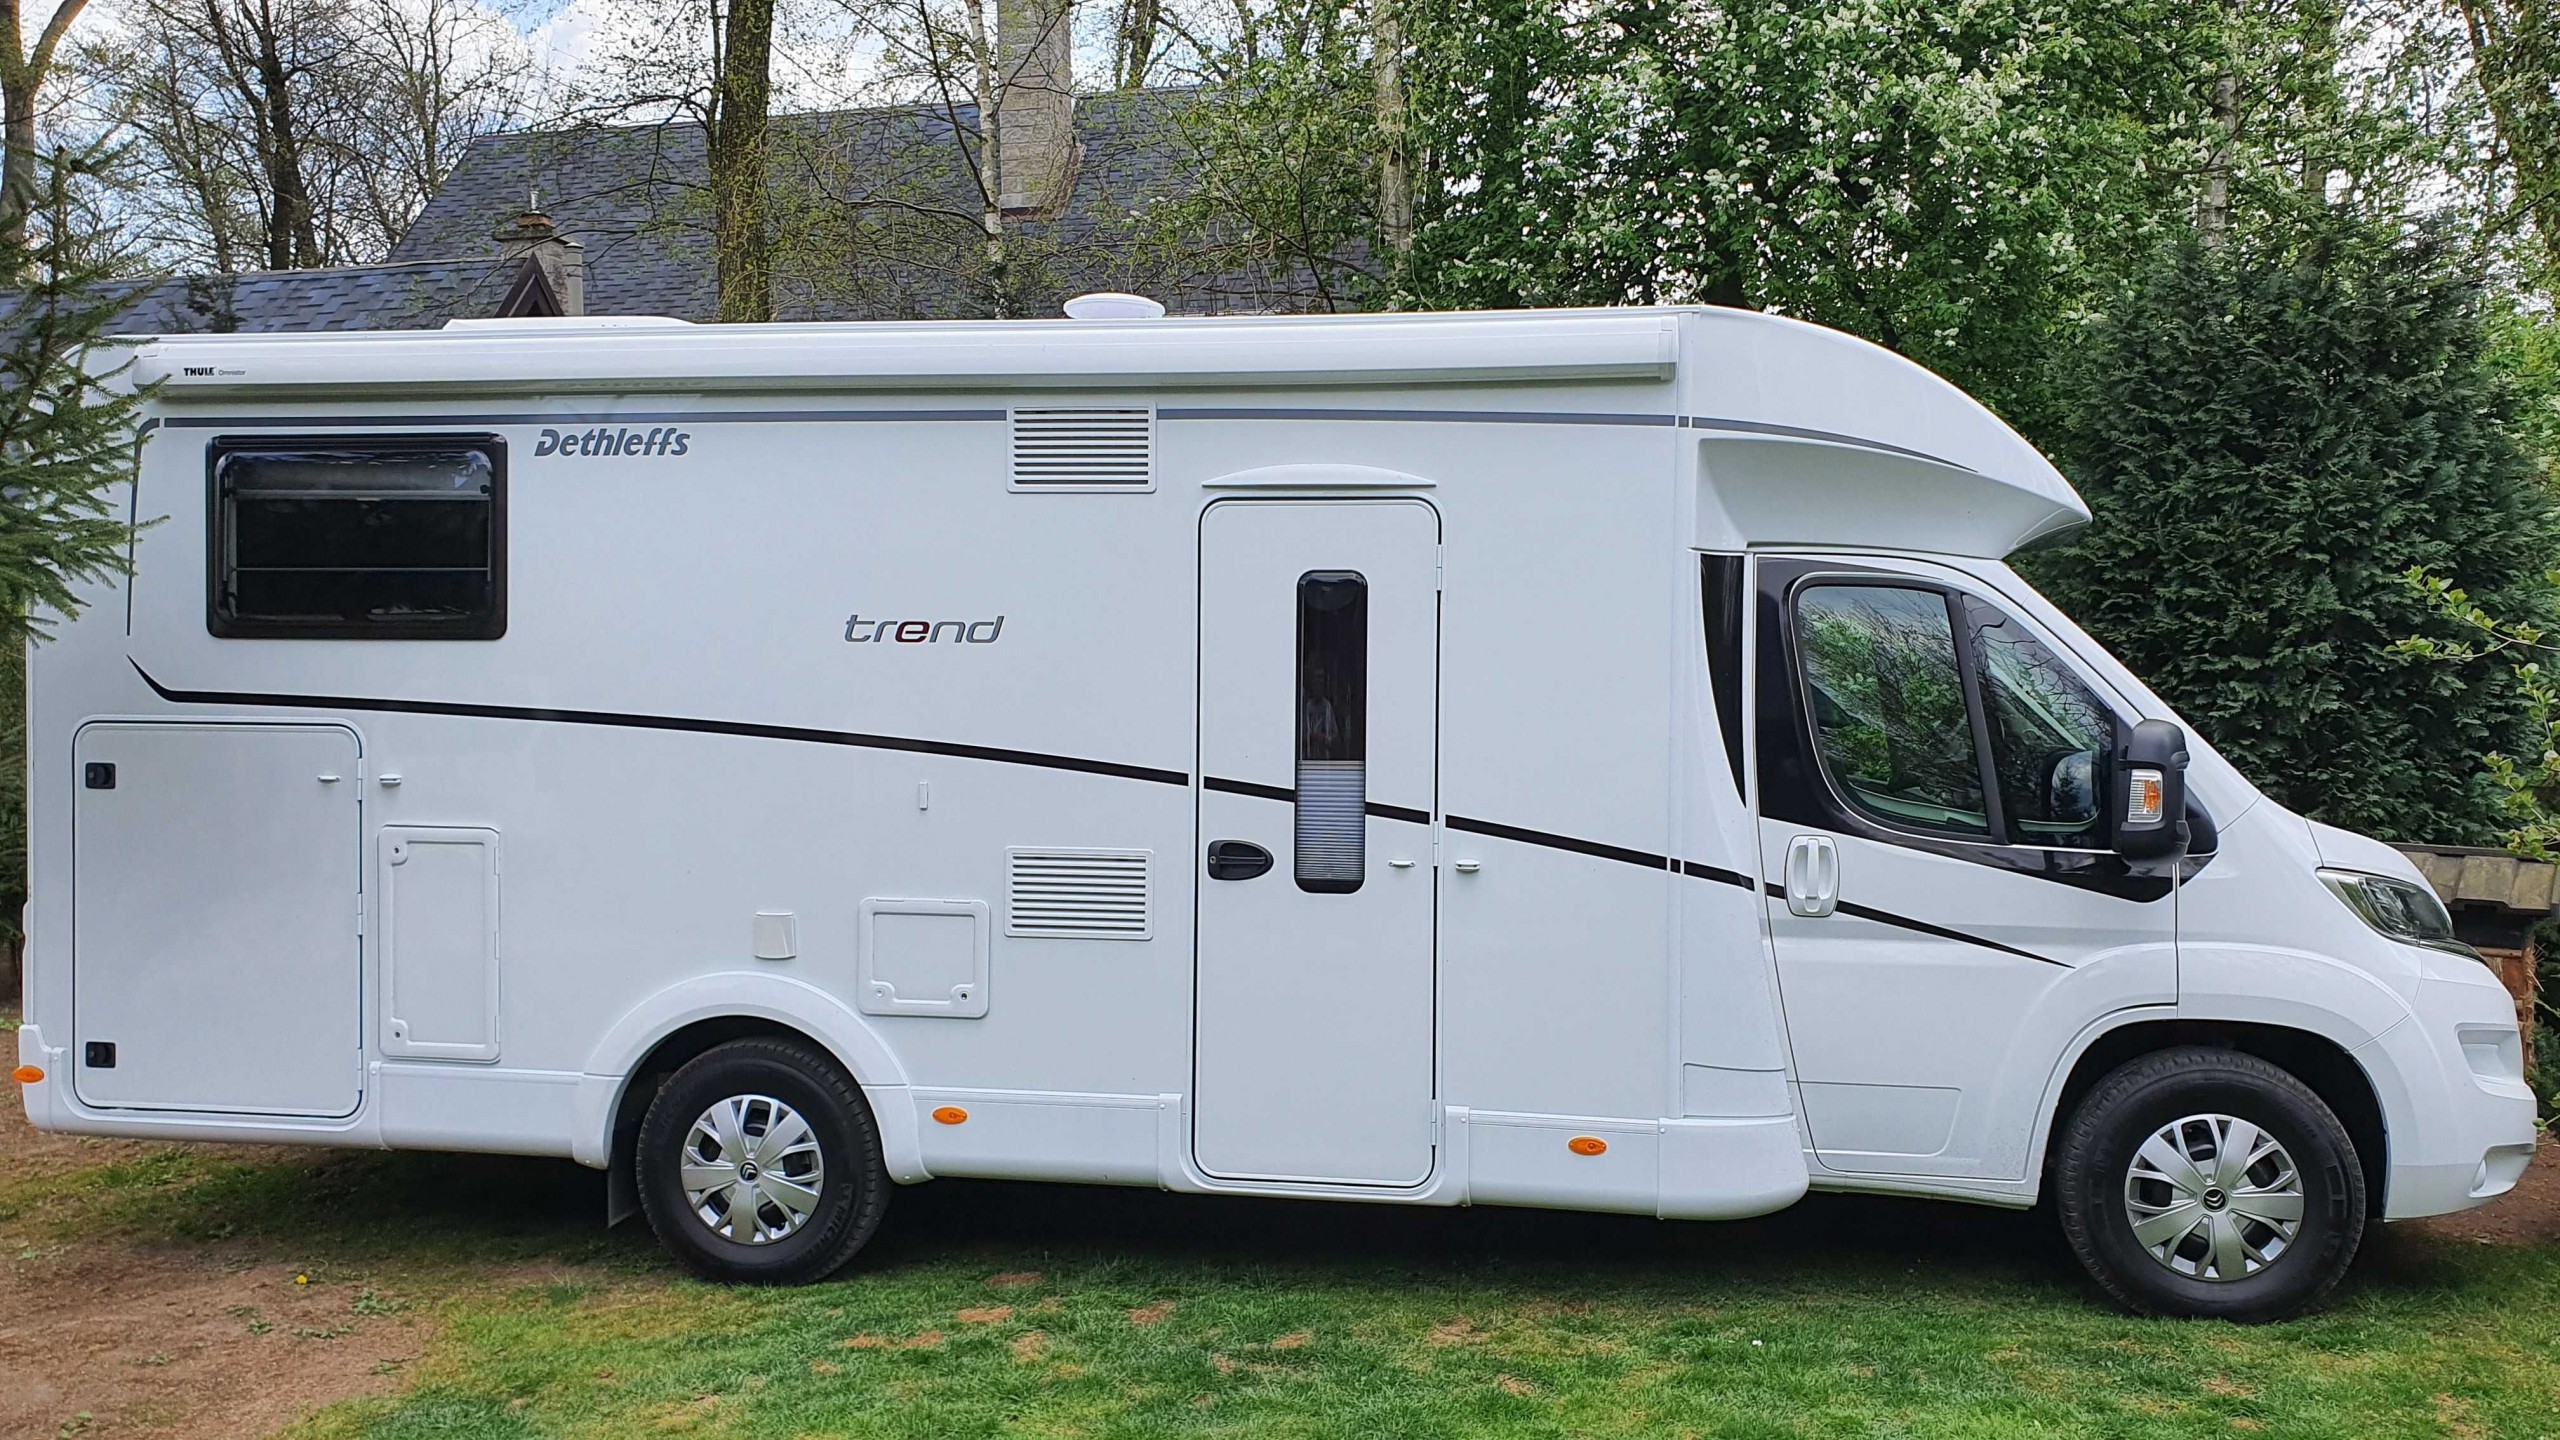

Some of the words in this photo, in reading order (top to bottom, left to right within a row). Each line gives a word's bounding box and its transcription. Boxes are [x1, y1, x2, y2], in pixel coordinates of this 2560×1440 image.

[184, 368, 214, 376] THULE
[534, 427, 690, 457] Dethleffs
[845, 614, 1005, 644] trend
